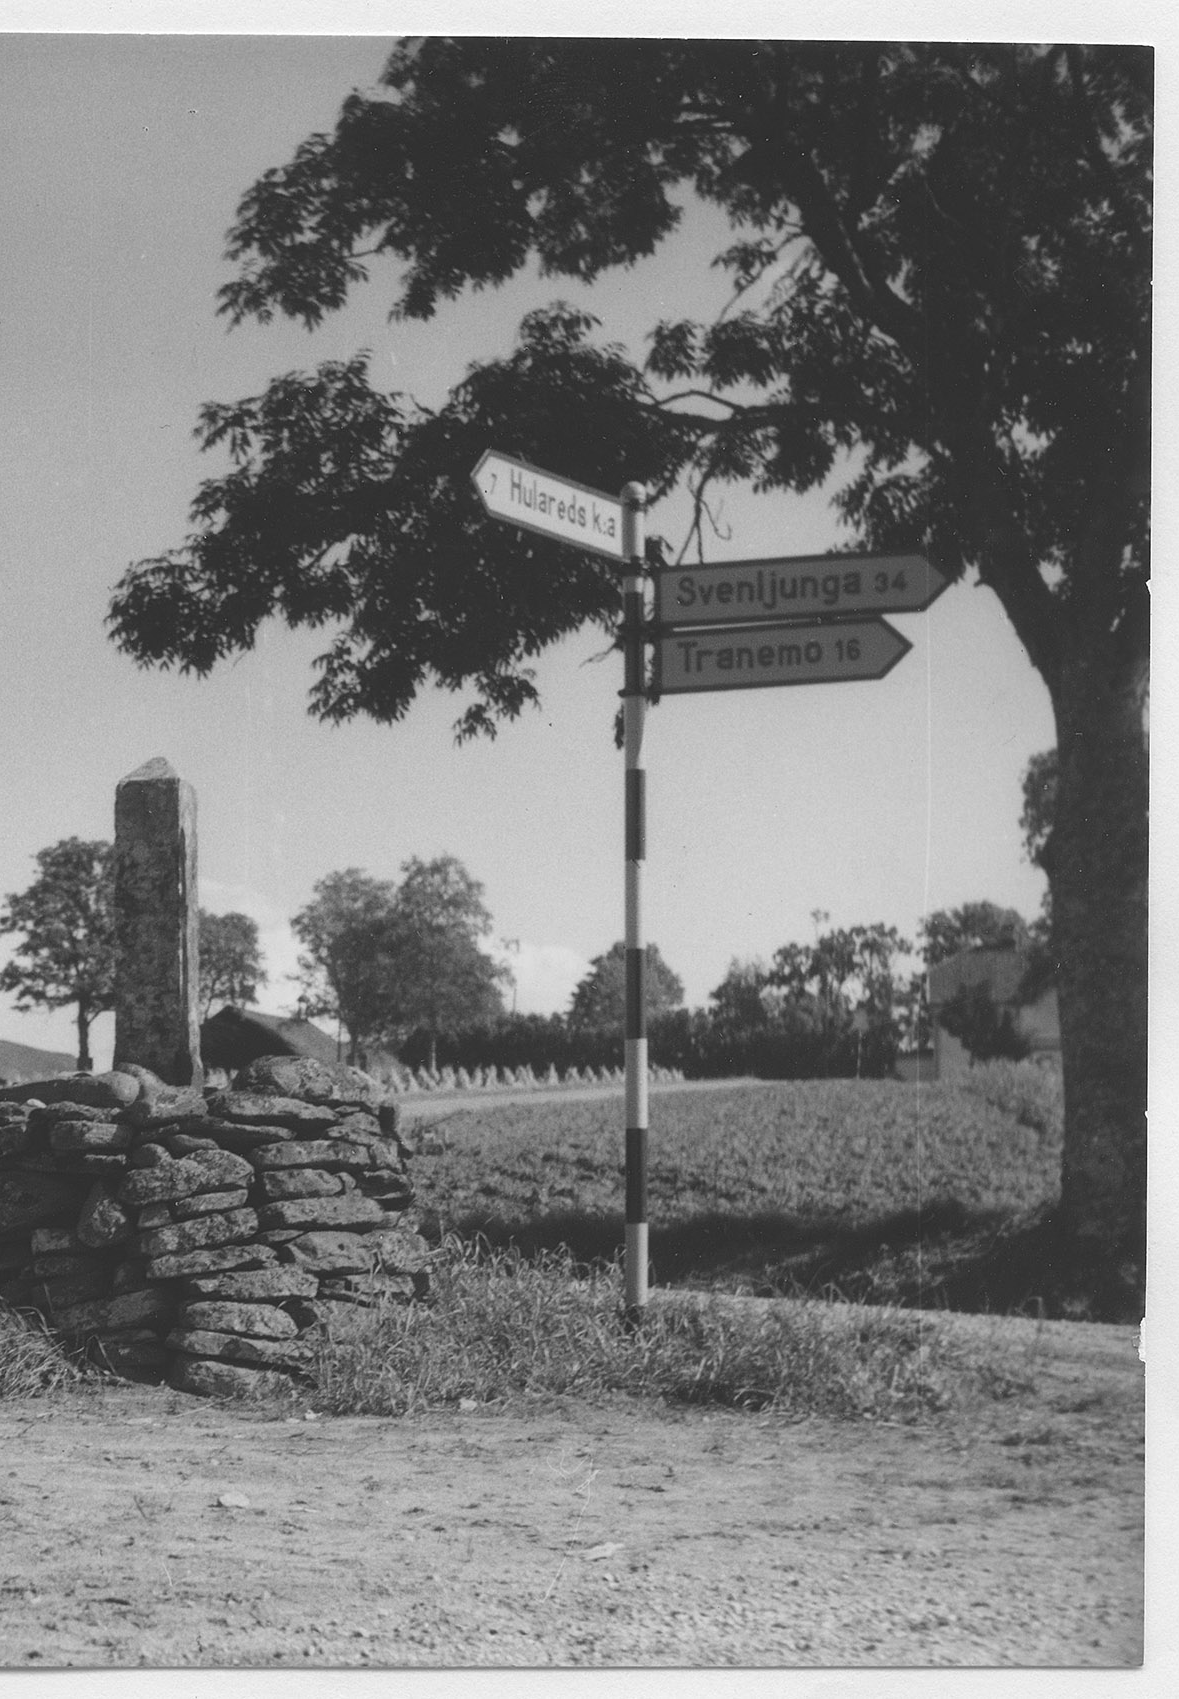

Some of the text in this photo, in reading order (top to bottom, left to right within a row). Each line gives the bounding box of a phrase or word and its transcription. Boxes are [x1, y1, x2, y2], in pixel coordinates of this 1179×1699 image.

[510, 468, 587, 528] Hulareds
[677, 570, 907, 609] Svenljunga 34
[677, 638, 861, 673] Tranemo 16
